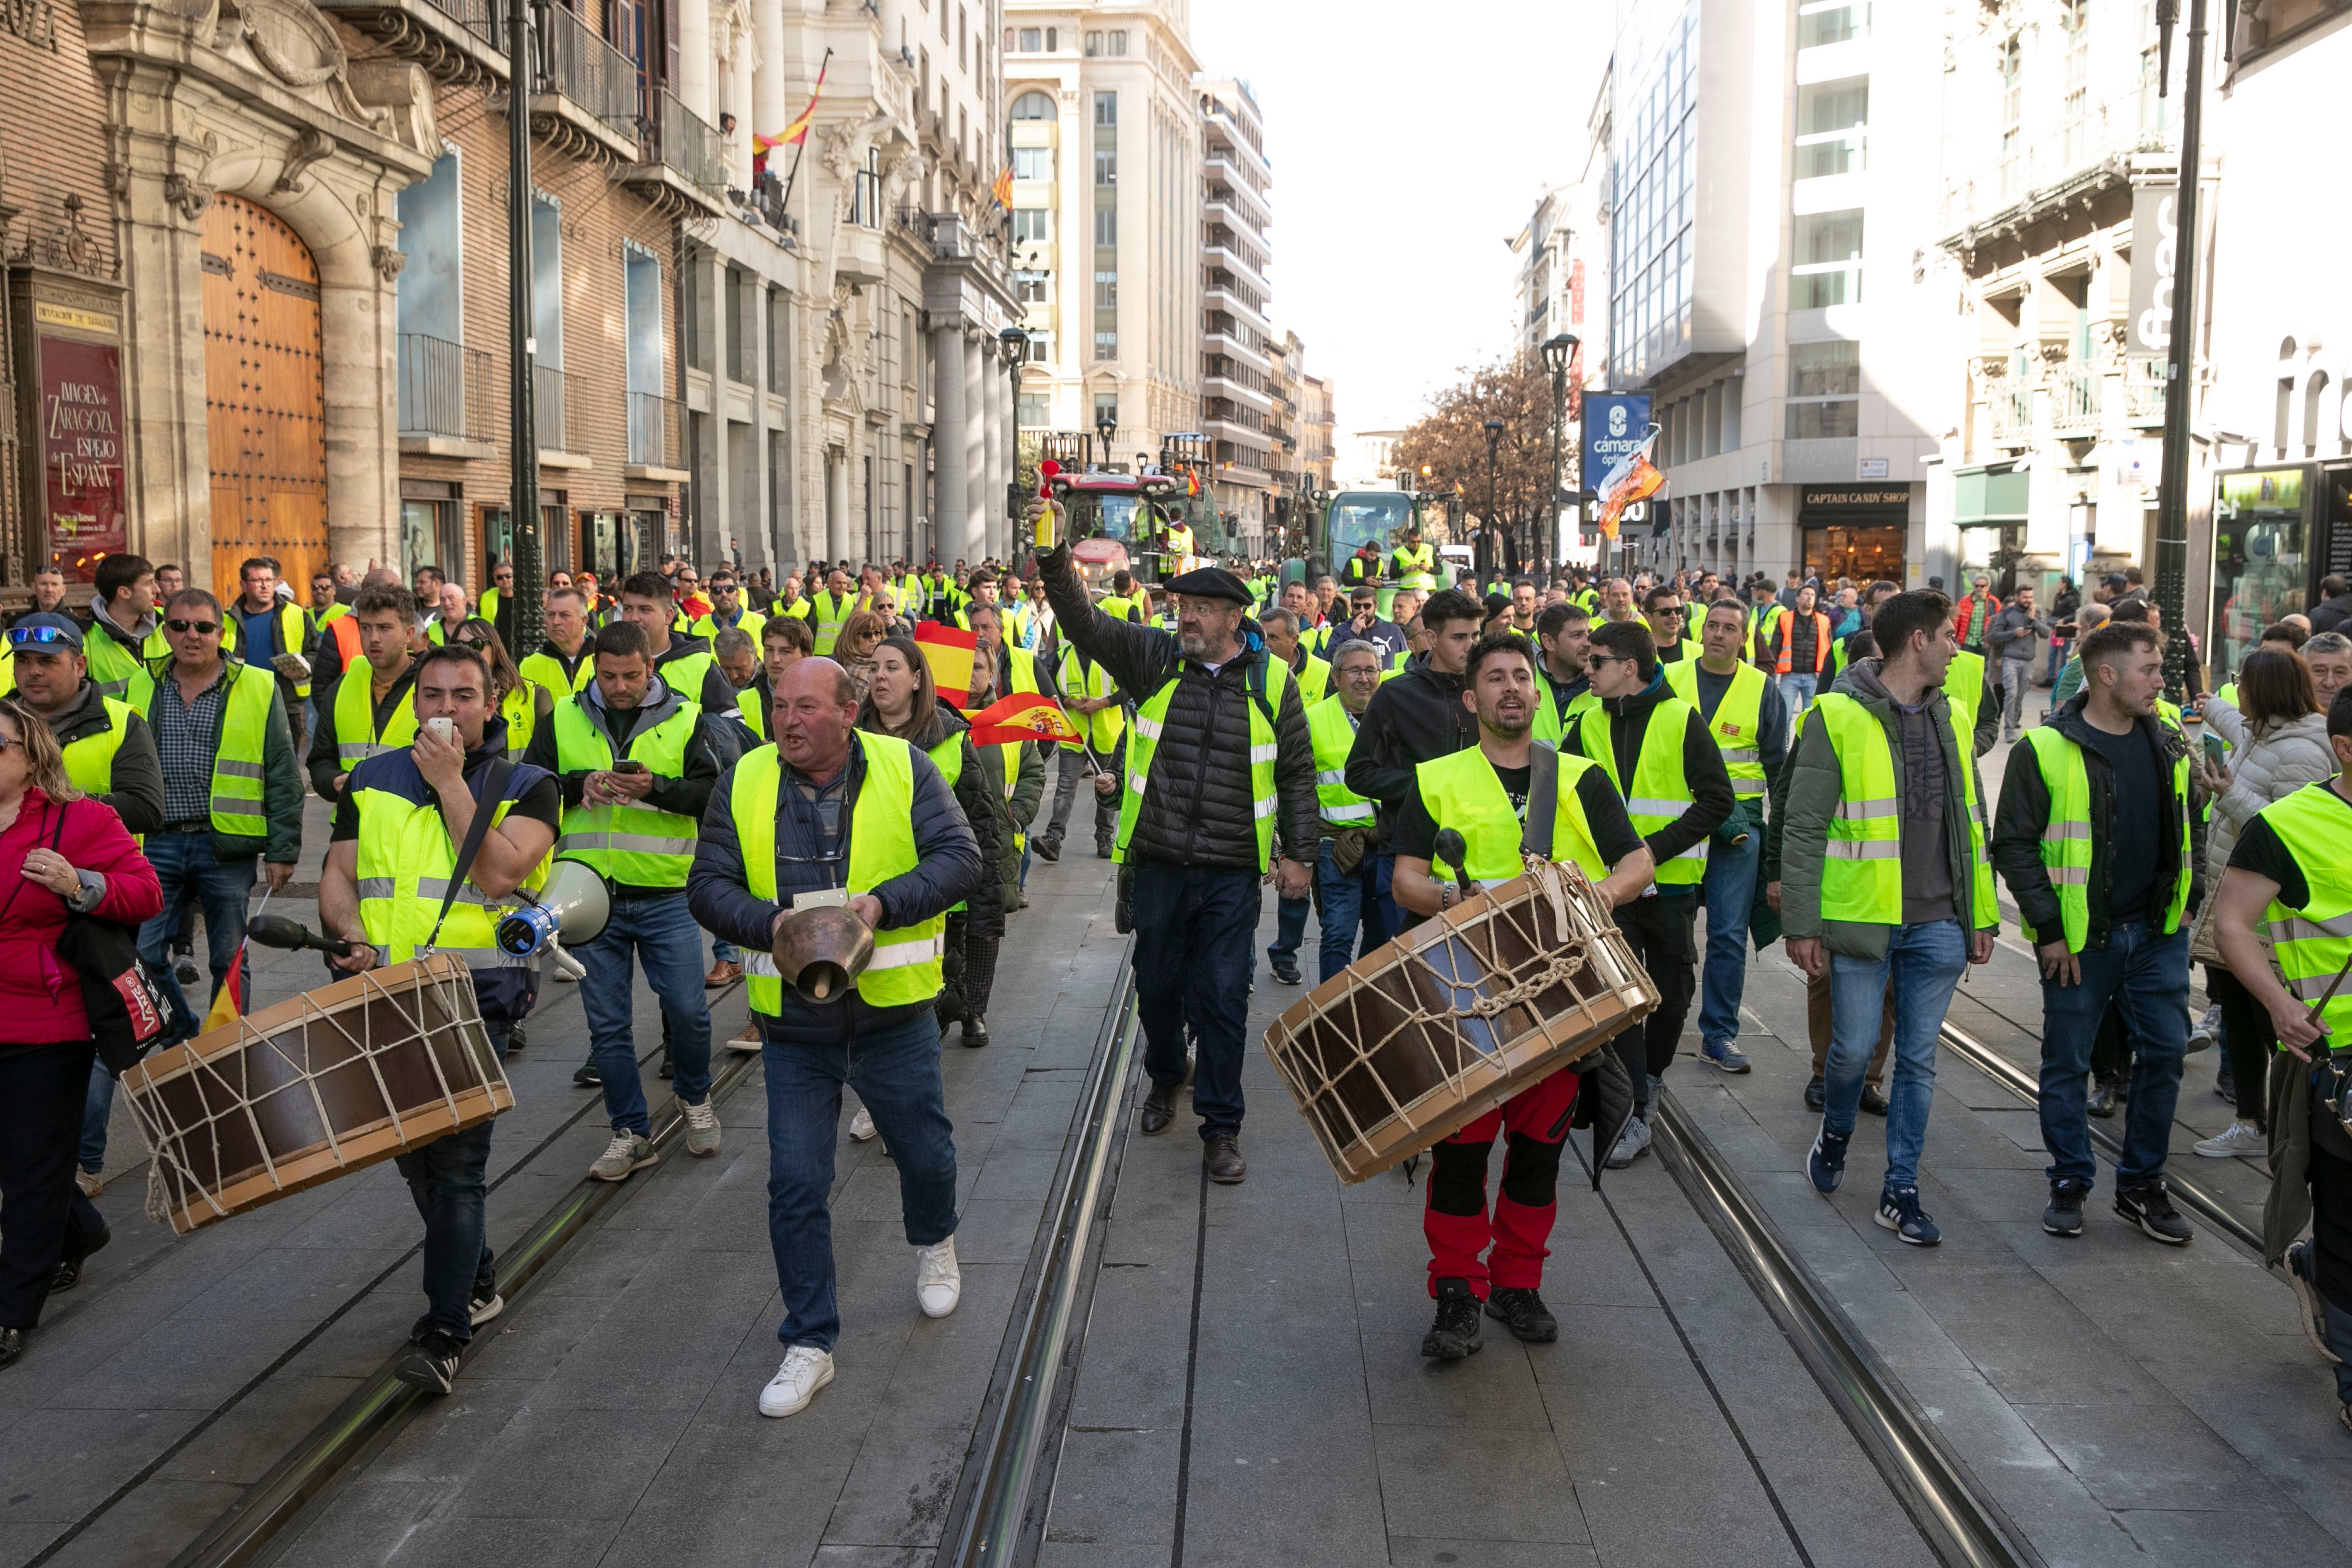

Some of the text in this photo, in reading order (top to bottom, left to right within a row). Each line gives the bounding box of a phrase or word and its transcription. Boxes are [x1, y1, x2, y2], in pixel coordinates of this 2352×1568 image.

[61, 381, 109, 405] IMAGEN de
[77, 436, 116, 459] ESPEJO
[1593, 435, 1642, 453] cámara
[50, 451, 111, 496] de ESPAÑA
[1806, 491, 1910, 504] CAPTAIN CANDY SHOP
[131, 985, 156, 1033] VANS
